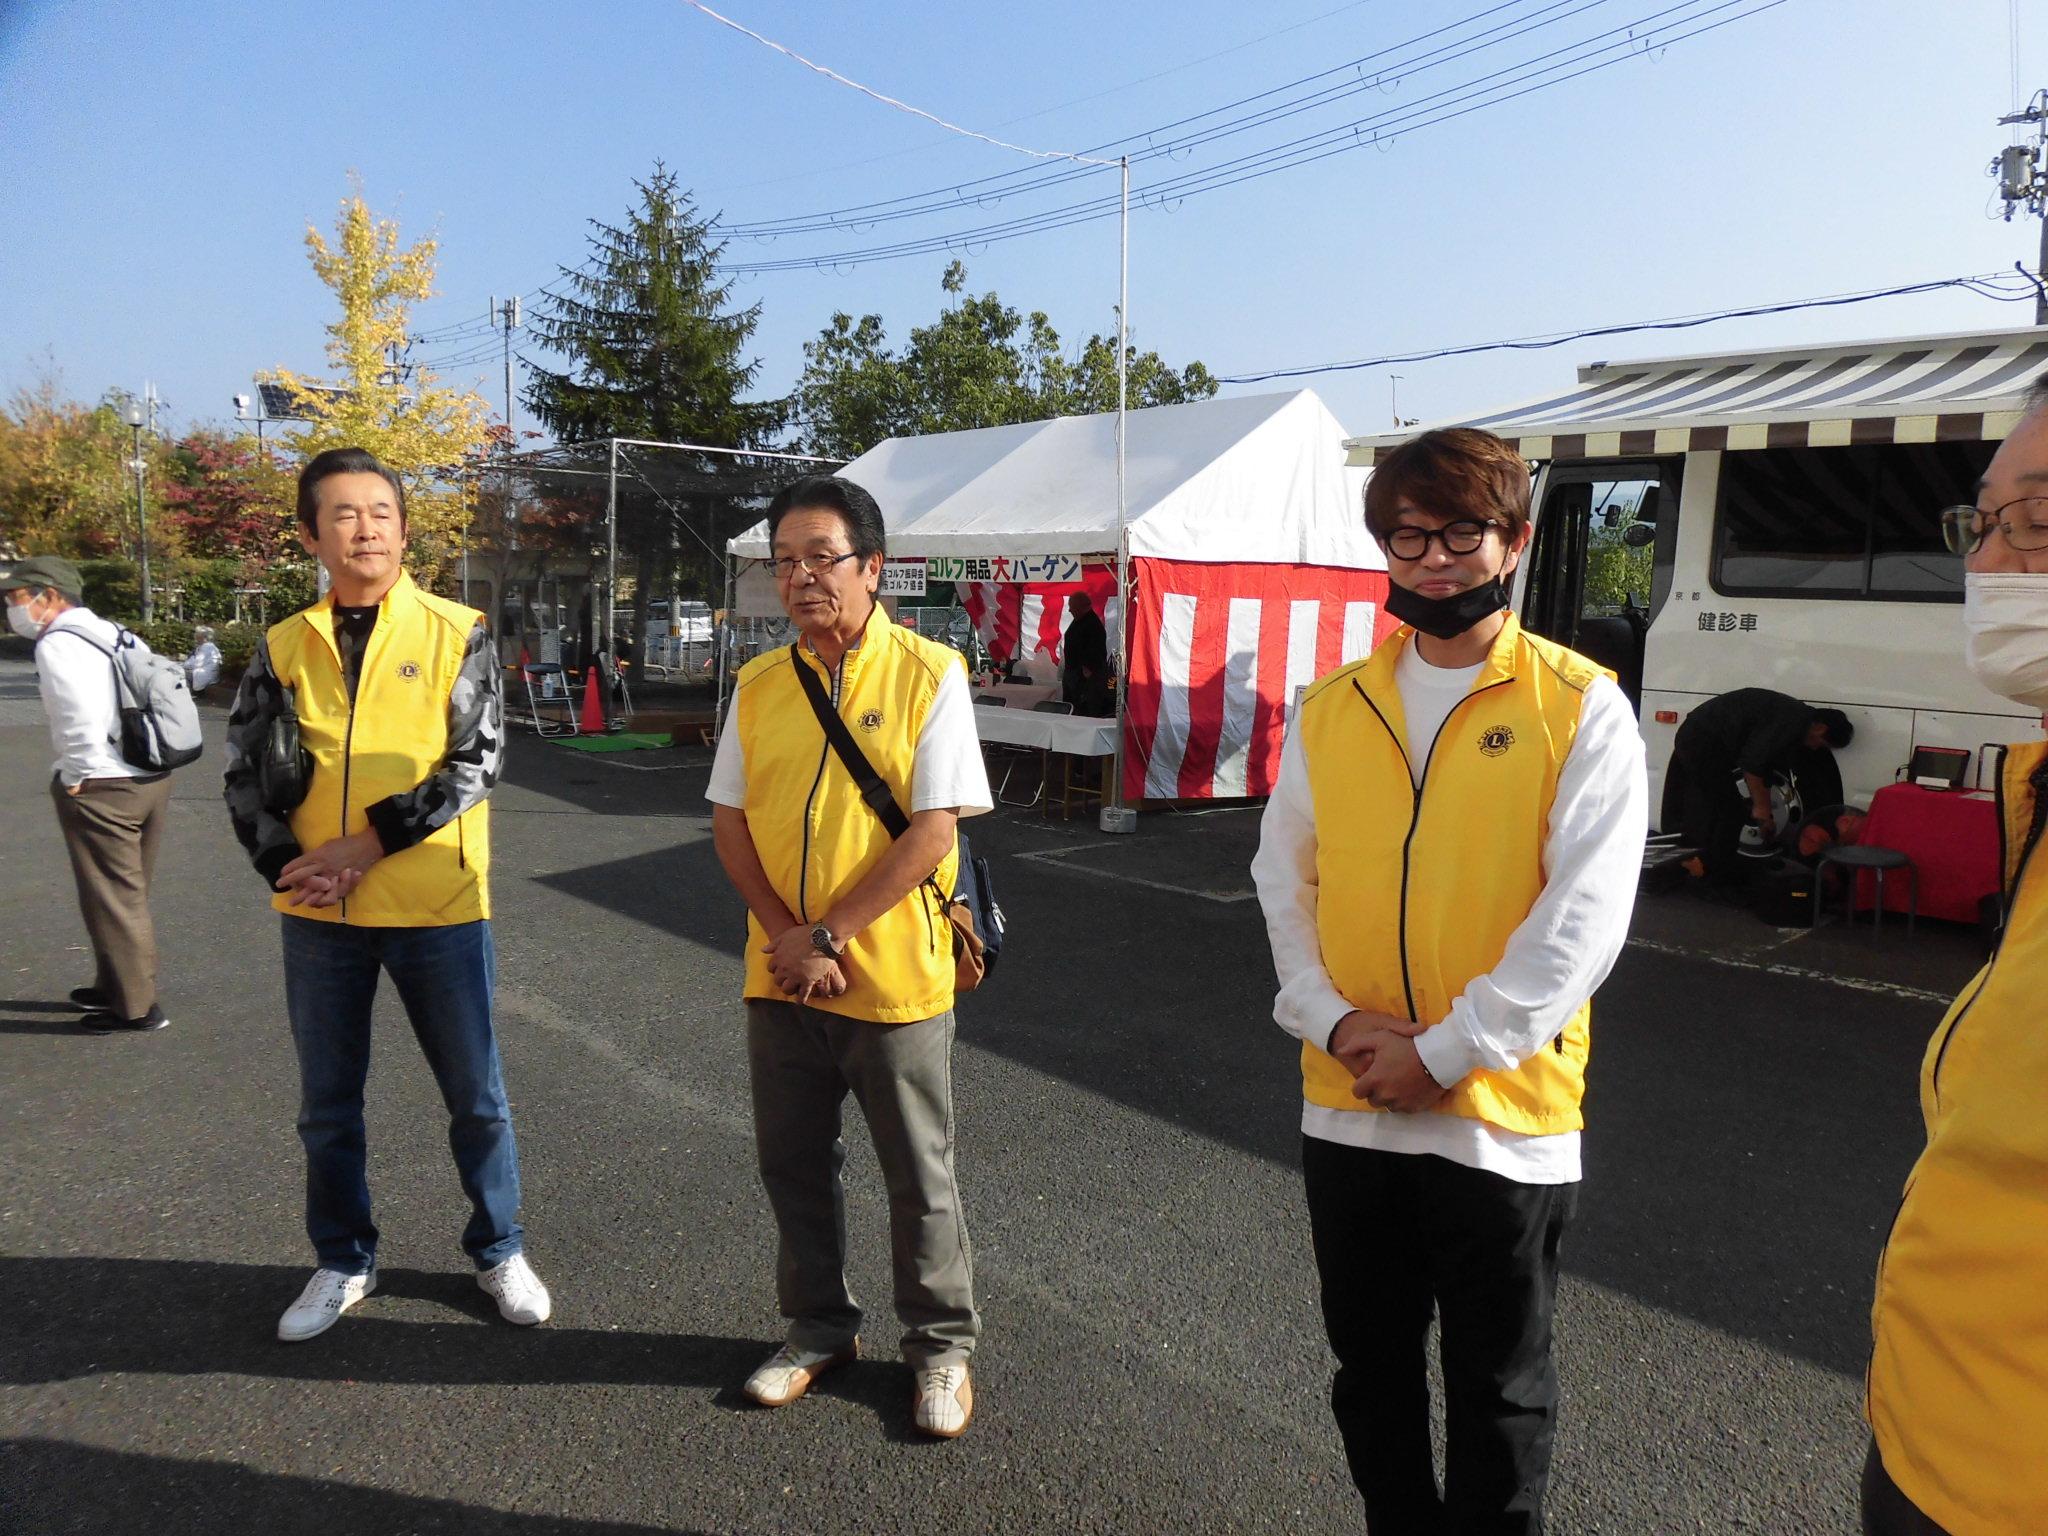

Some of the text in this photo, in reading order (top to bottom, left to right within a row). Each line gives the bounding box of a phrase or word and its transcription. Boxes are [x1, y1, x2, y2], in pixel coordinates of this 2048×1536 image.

[928, 554, 1079, 581] ゴルフ用品大バーゲン
[1697, 612, 1758, 632] 健診車
[1490, 734, 1501, 746] L
